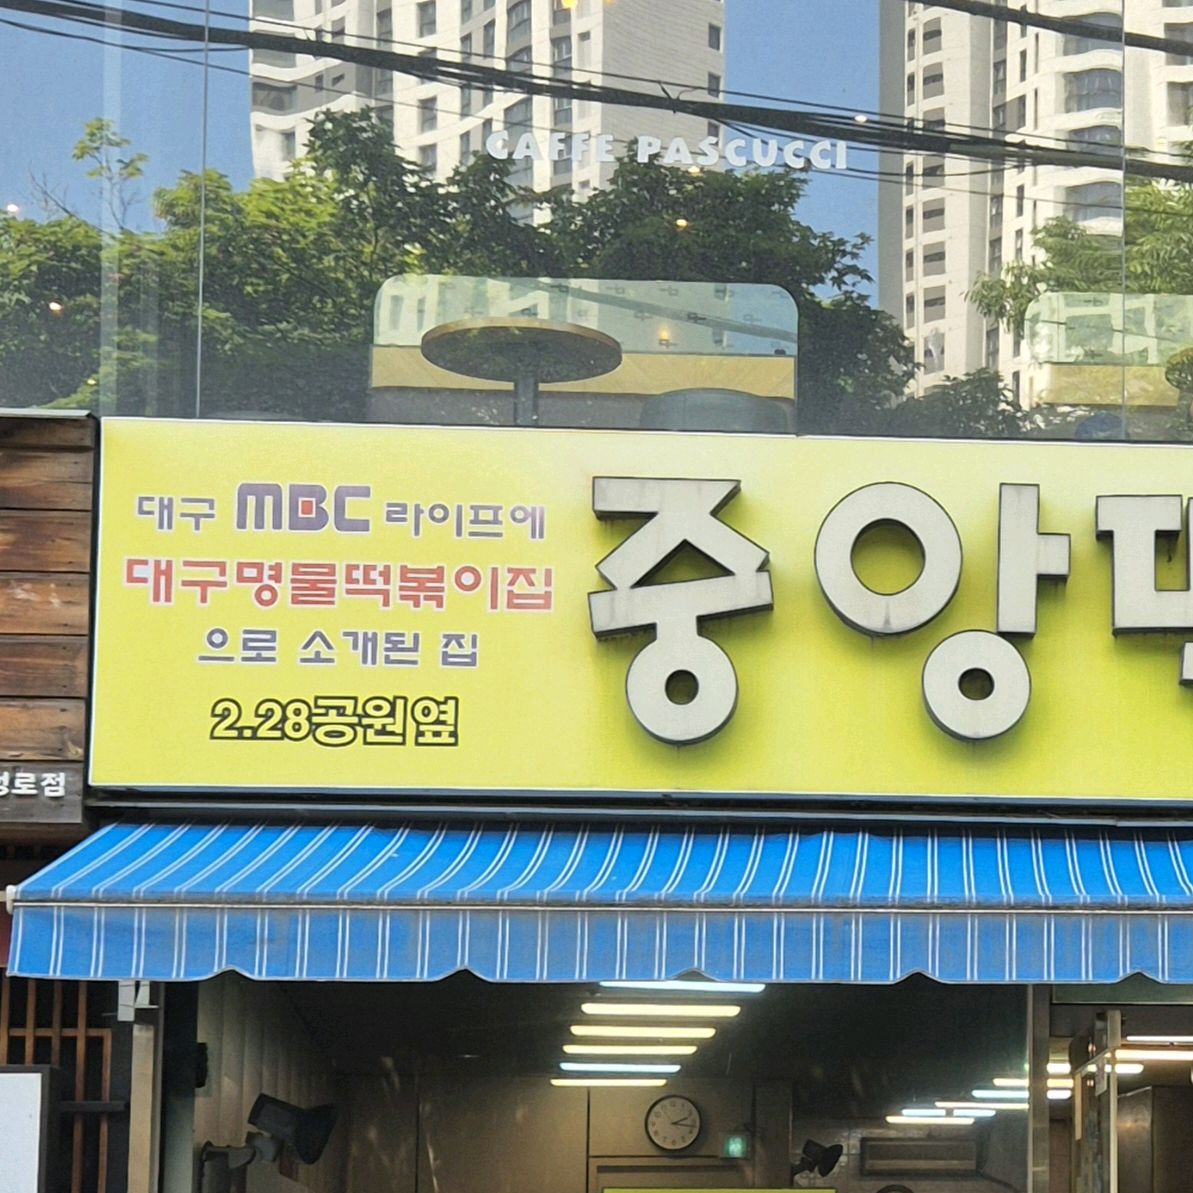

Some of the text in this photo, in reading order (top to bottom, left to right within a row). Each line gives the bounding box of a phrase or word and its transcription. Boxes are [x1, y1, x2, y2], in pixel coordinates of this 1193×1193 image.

[486, 130, 848, 170] CAFFE PASCUCCI
[136, 482, 546, 540] 대구 MBC 라이프에
[124, 558, 554, 612] 대구명물떡볶이집
[198, 628, 479, 668] 으로 소개된 집
